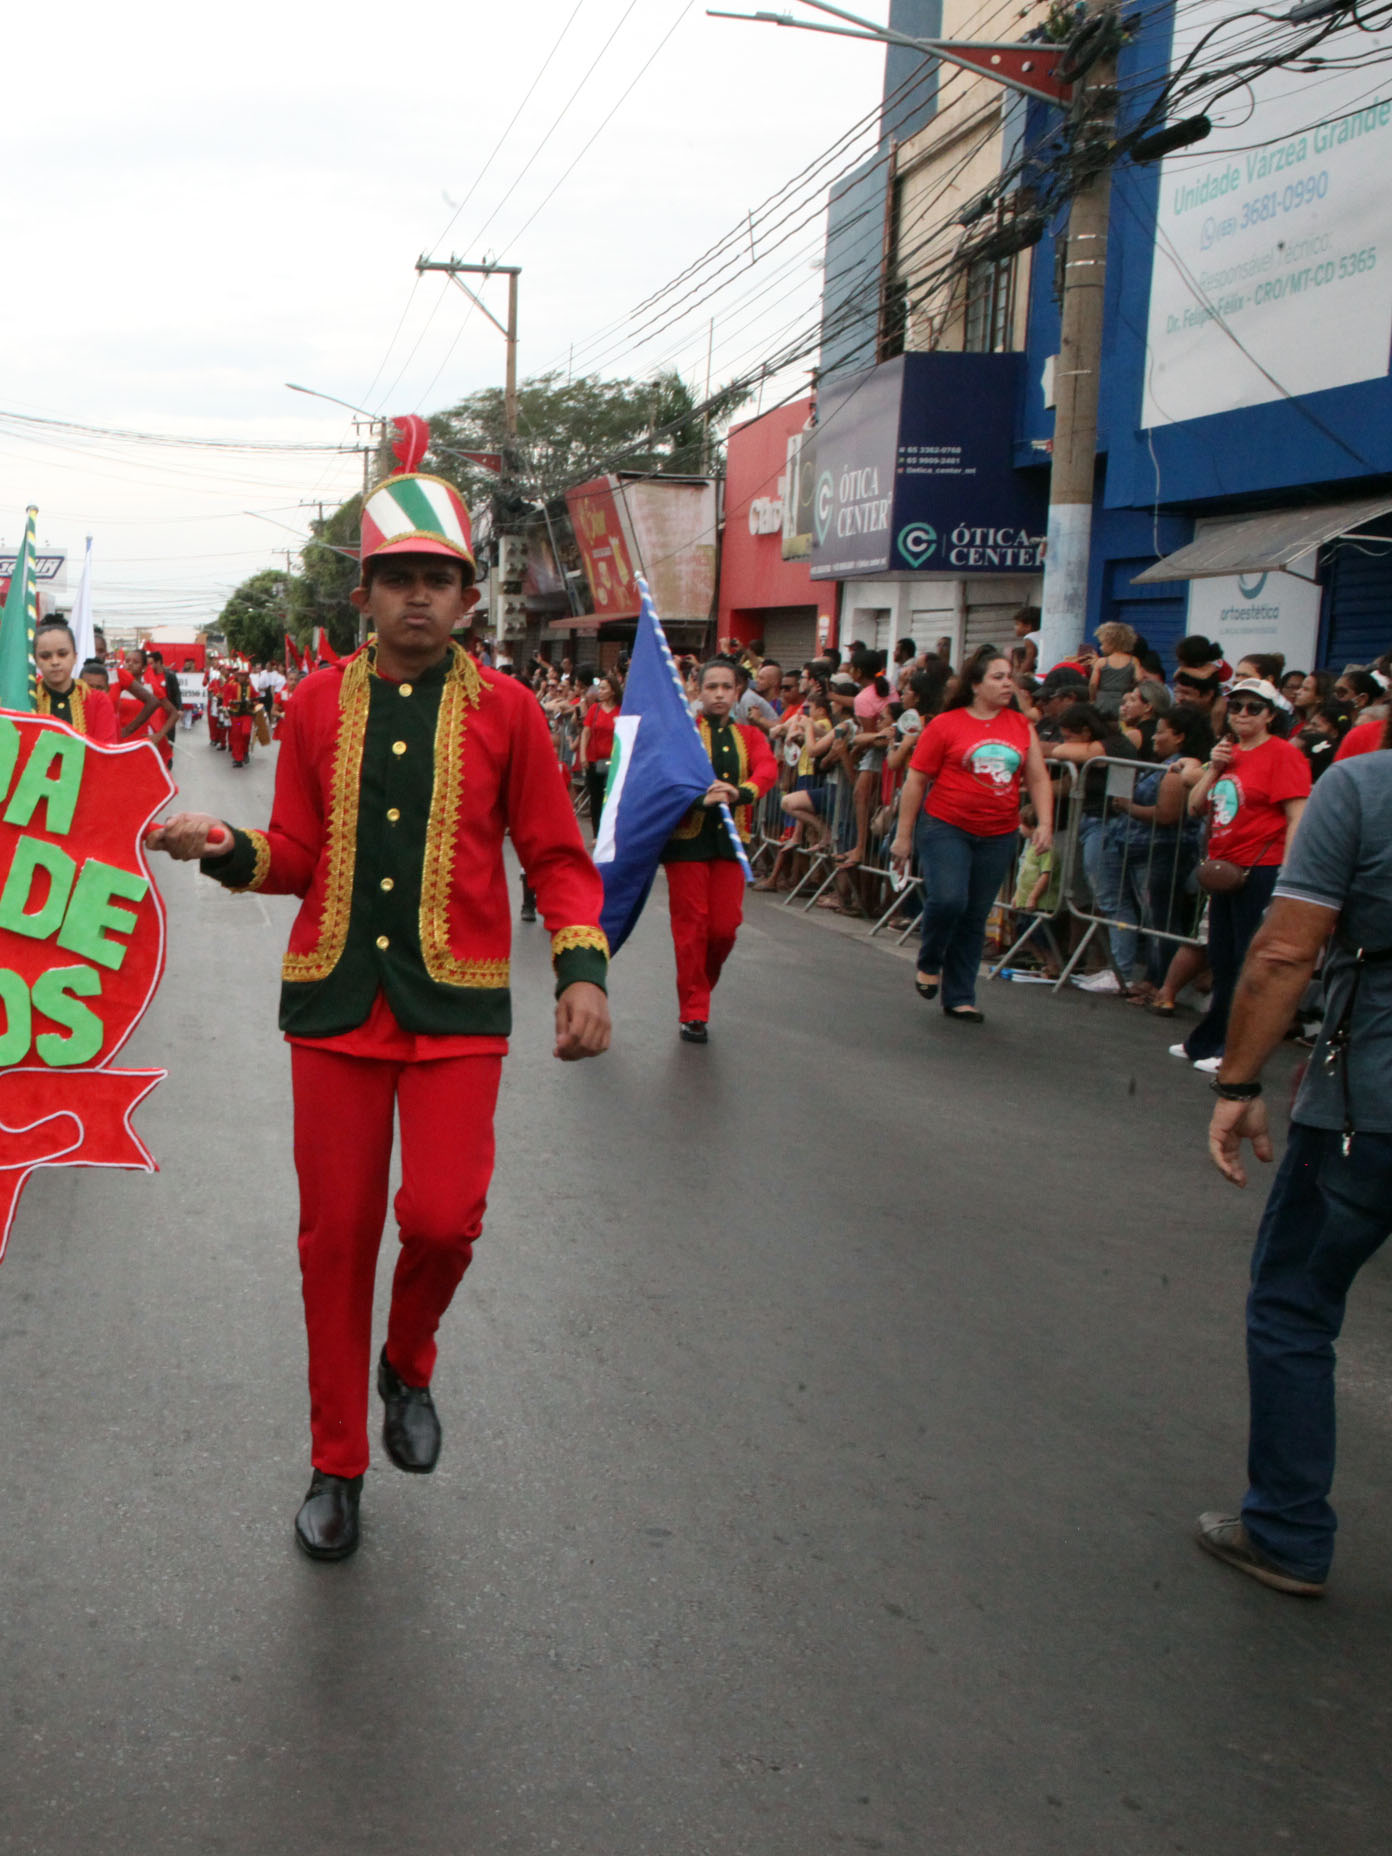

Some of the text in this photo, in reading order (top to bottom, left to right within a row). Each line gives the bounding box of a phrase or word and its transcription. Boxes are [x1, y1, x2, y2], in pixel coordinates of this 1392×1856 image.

[1173, 96, 1392, 215] Unidade Várzea Grande
[1240, 170, 1329, 230] 3681-0990
[1254, 261, 1335, 306] CRO/MT-CD
[1338, 246, 1377, 280] 5365
[838, 463, 879, 503] ÓTICA
[837, 499, 889, 538] CENTER
[951, 522, 1030, 546] ÓTICA
